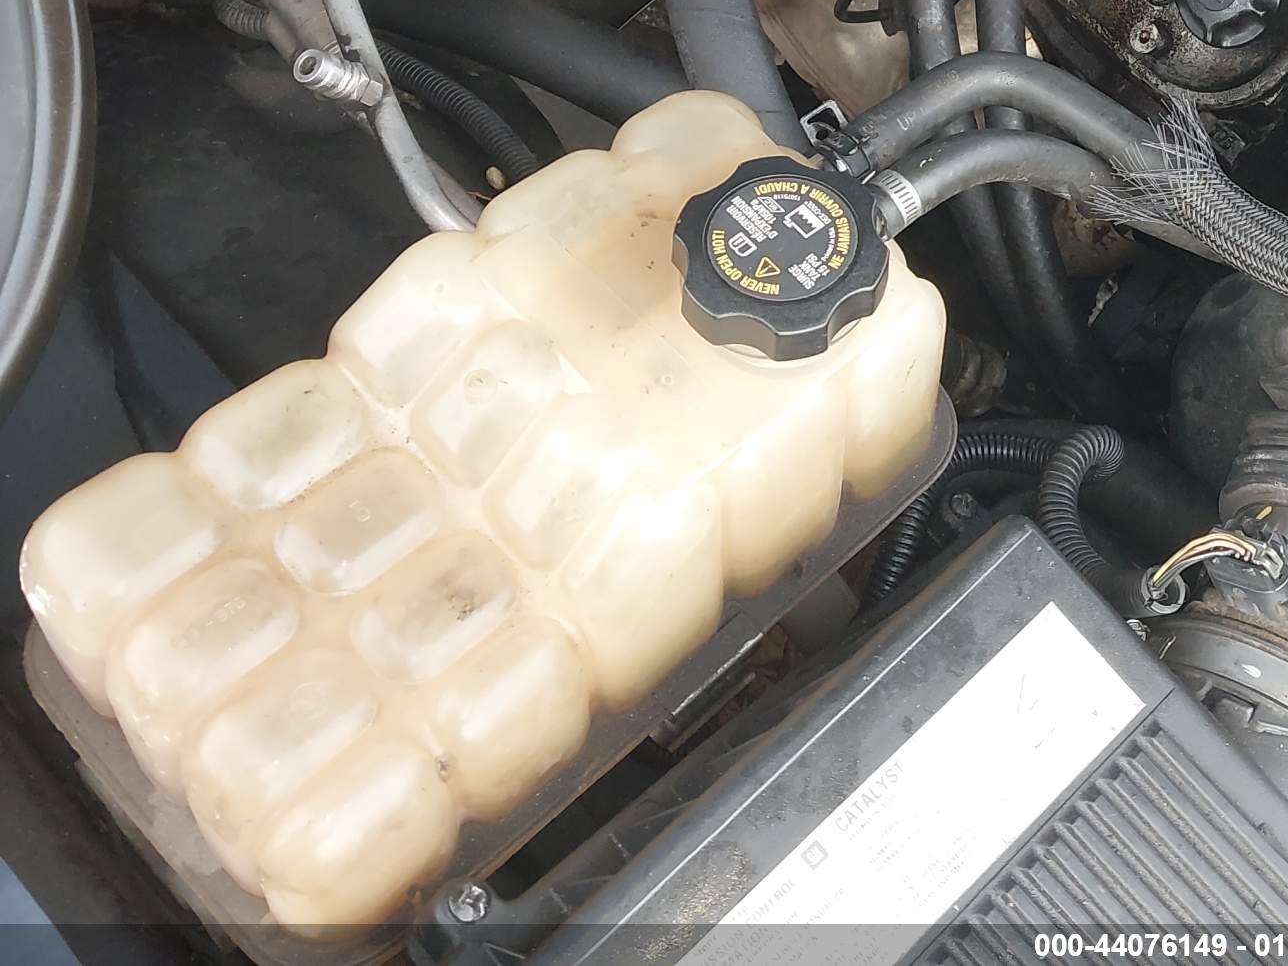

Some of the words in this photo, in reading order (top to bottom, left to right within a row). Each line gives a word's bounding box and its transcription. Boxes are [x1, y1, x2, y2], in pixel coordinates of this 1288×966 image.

[754, 181, 798, 195] CHAUD!
[809, 188, 844, 217] OUVRIR
[726, 204, 767, 242] RÉSERVOIR
[731, 196, 779, 239] D'EXPANSION
[712, 230, 726, 254] HOT!
[835, 217, 850, 255] JAMAIS
[716, 254, 742, 280] OPEN
[799, 260, 821, 281] TANK
[805, 253, 822, 268] PSI
[828, 254, 845, 269] NE
[740, 276, 779, 295] NEVER
[788, 264, 815, 289] SURGE
[835, 761, 904, 832] CATALYST
